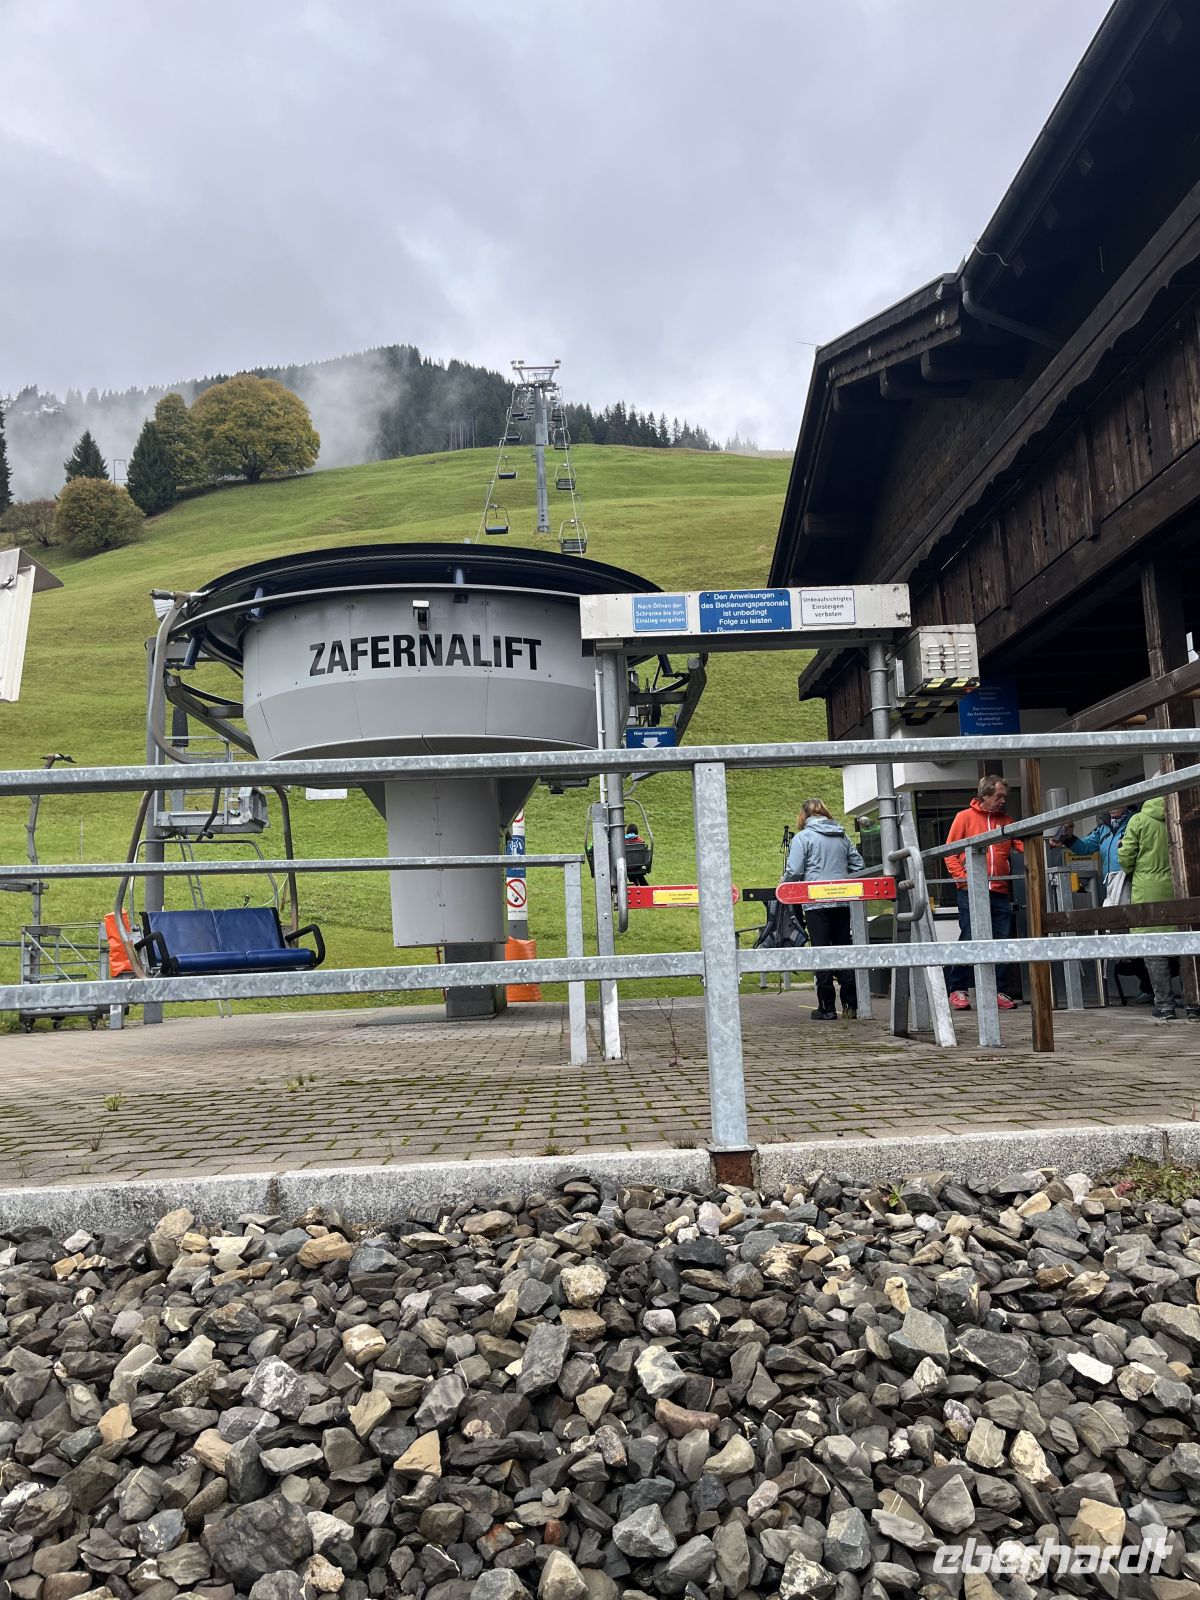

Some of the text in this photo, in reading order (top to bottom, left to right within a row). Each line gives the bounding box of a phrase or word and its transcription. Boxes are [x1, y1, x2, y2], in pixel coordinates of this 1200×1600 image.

[729, 592, 775, 600] Anweisungen
[715, 600, 789, 609] Bedienungspersonals
[732, 608, 768, 617] unbedingt
[719, 618, 739, 626] Folge
[309, 633, 542, 677] ZAFERNALIFT
